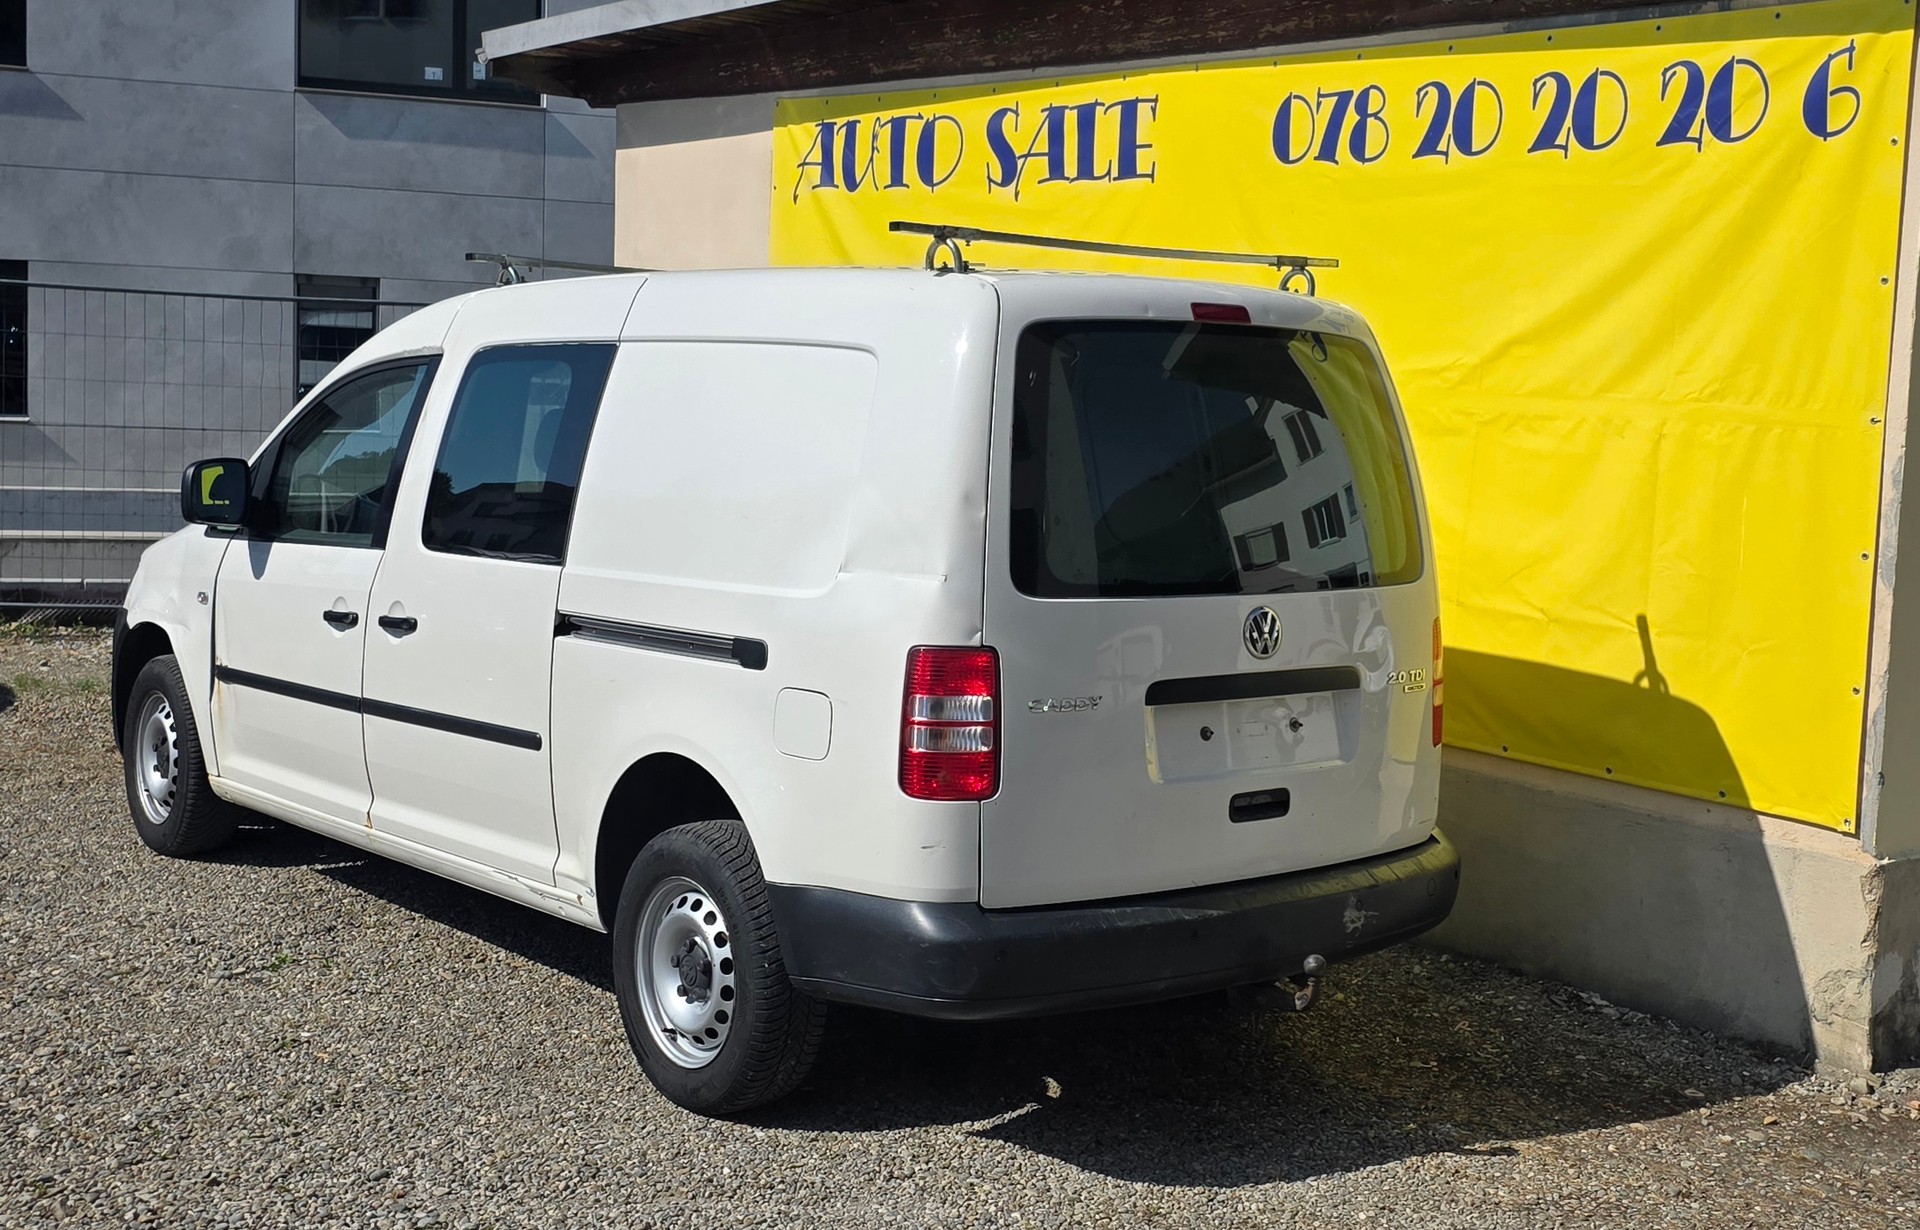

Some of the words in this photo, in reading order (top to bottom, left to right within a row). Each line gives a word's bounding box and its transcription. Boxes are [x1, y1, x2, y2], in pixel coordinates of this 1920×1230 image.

[1272, 84, 1390, 166] 078
[1411, 77, 1503, 165] 20
[1527, 67, 1629, 160] 20
[1655, 55, 1771, 153] 20
[1802, 38, 1862, 142] 6
[793, 113, 964, 205] AUTO
[986, 94, 1158, 202] SALE
[1027, 696, 1103, 713] CADDY
[1386, 671, 1406, 684] 2.0
[1409, 668, 1426, 682] TDI
